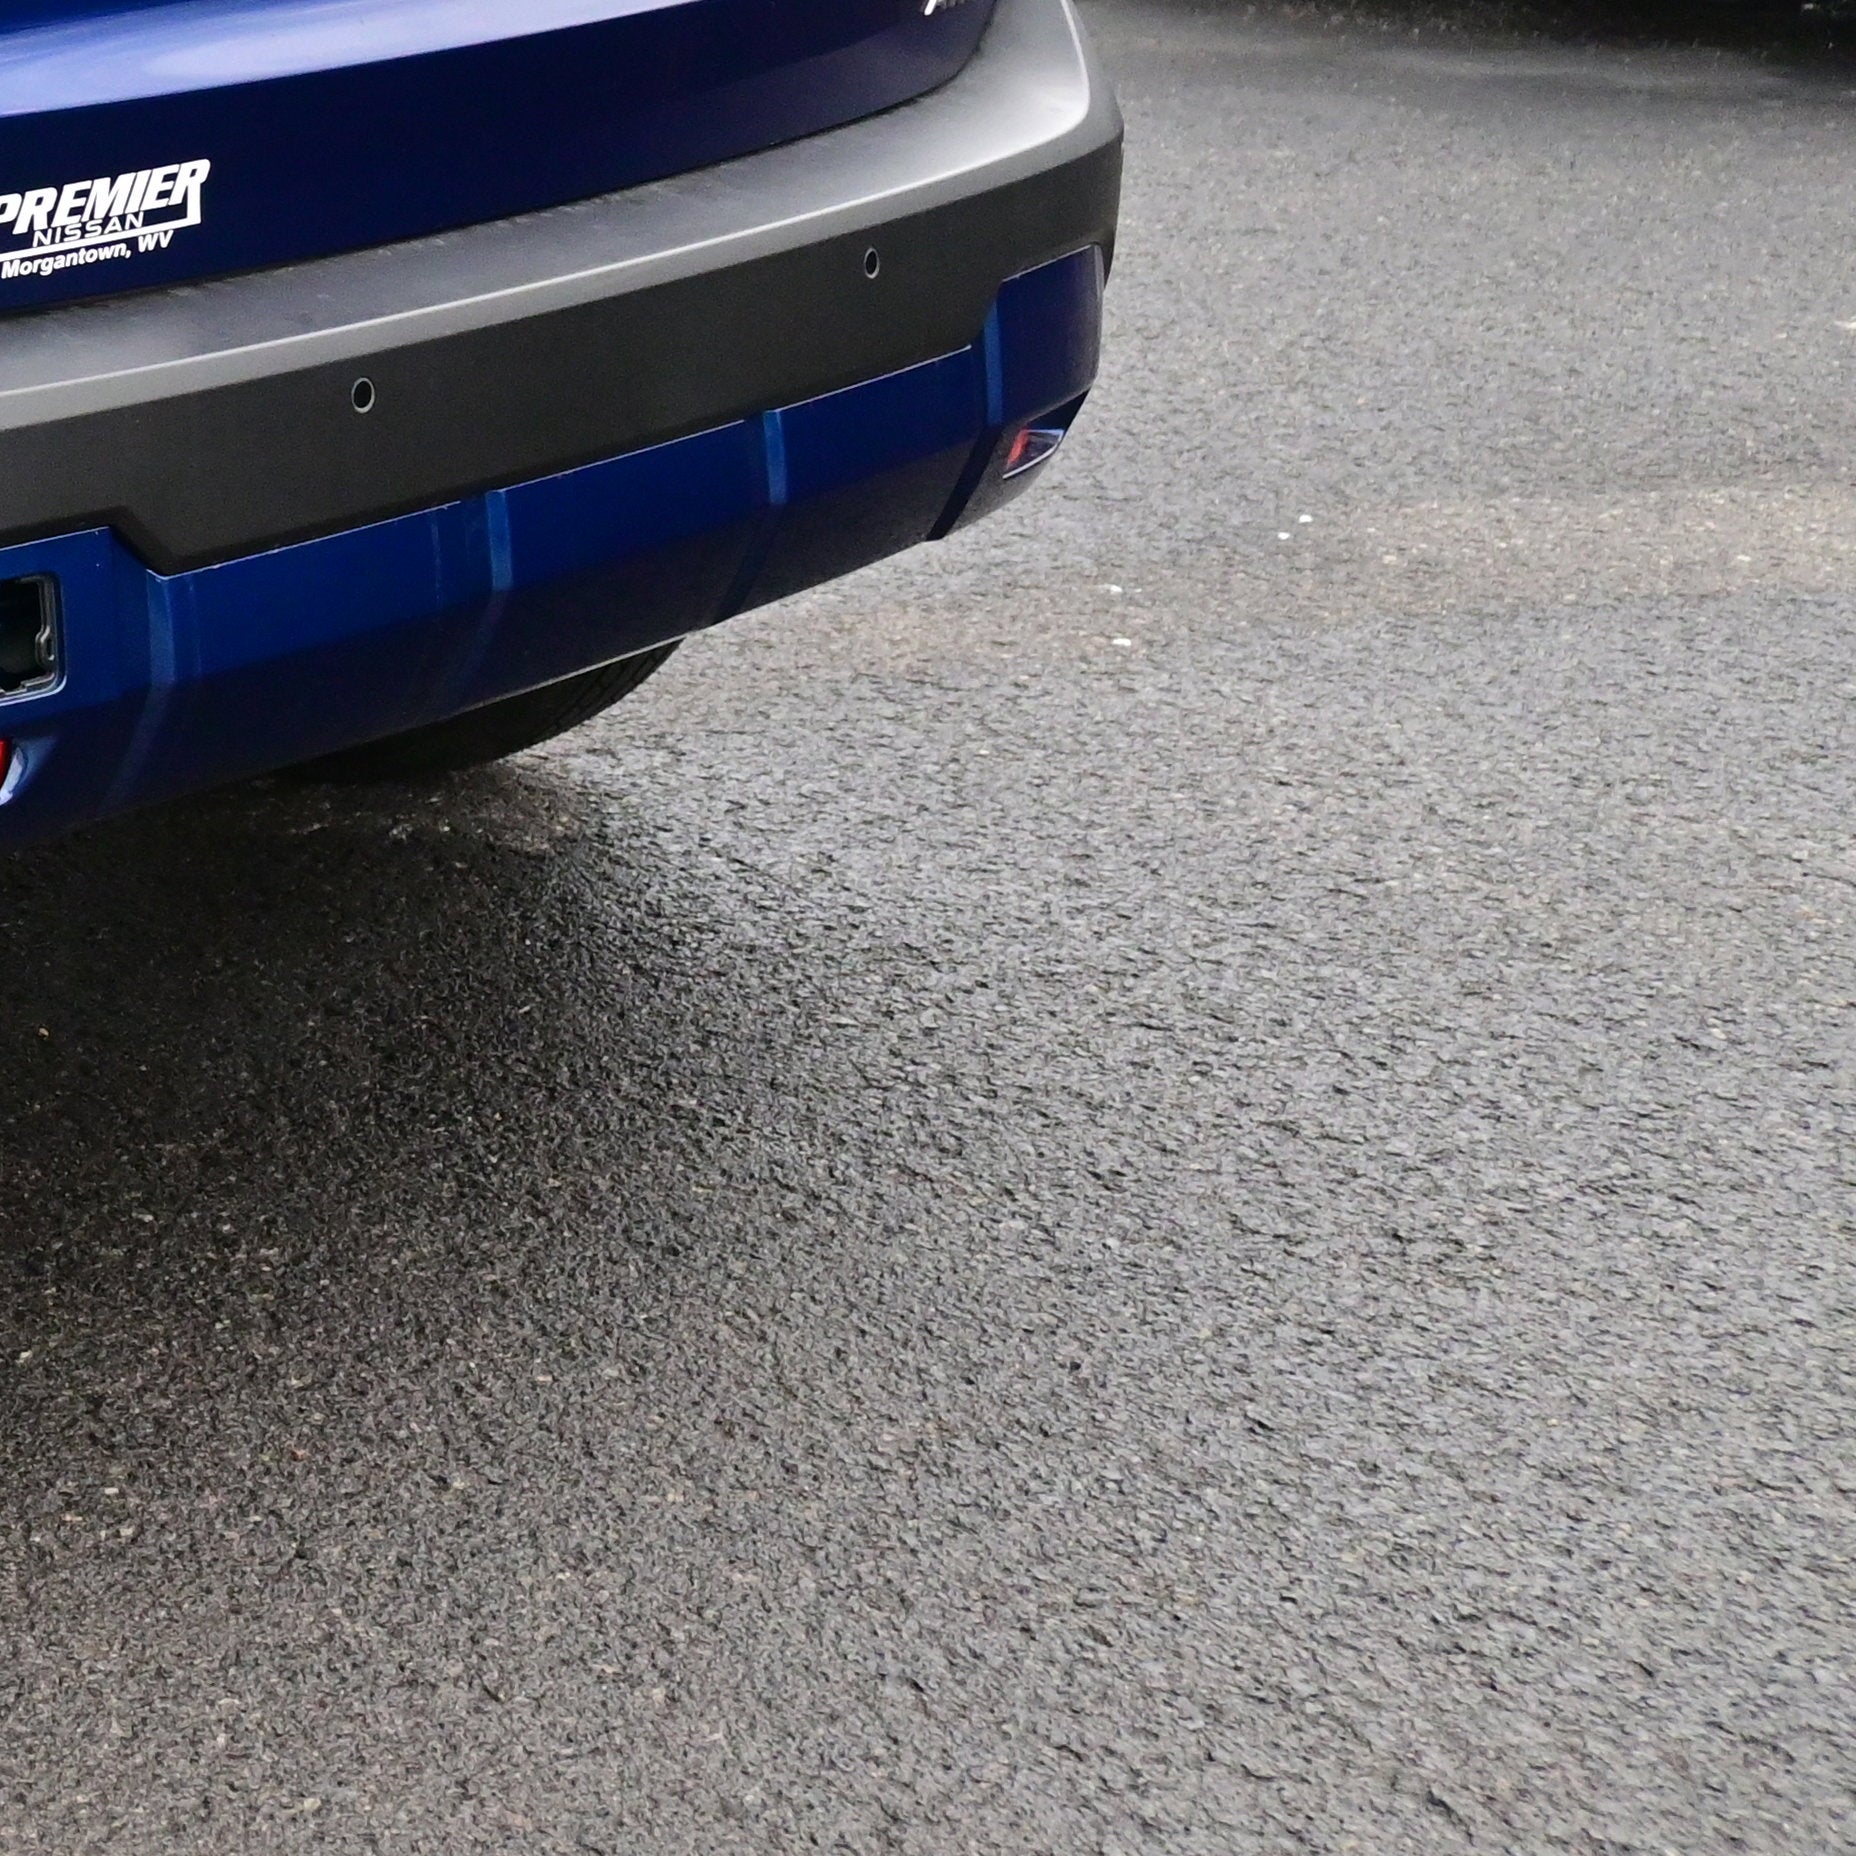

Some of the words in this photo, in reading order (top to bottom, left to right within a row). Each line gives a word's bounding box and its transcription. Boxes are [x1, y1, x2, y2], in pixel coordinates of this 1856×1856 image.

[32, 211, 145, 248] NISSAN
[1, 242, 132, 280] Morgantown,
[138, 229, 175, 254] WV
